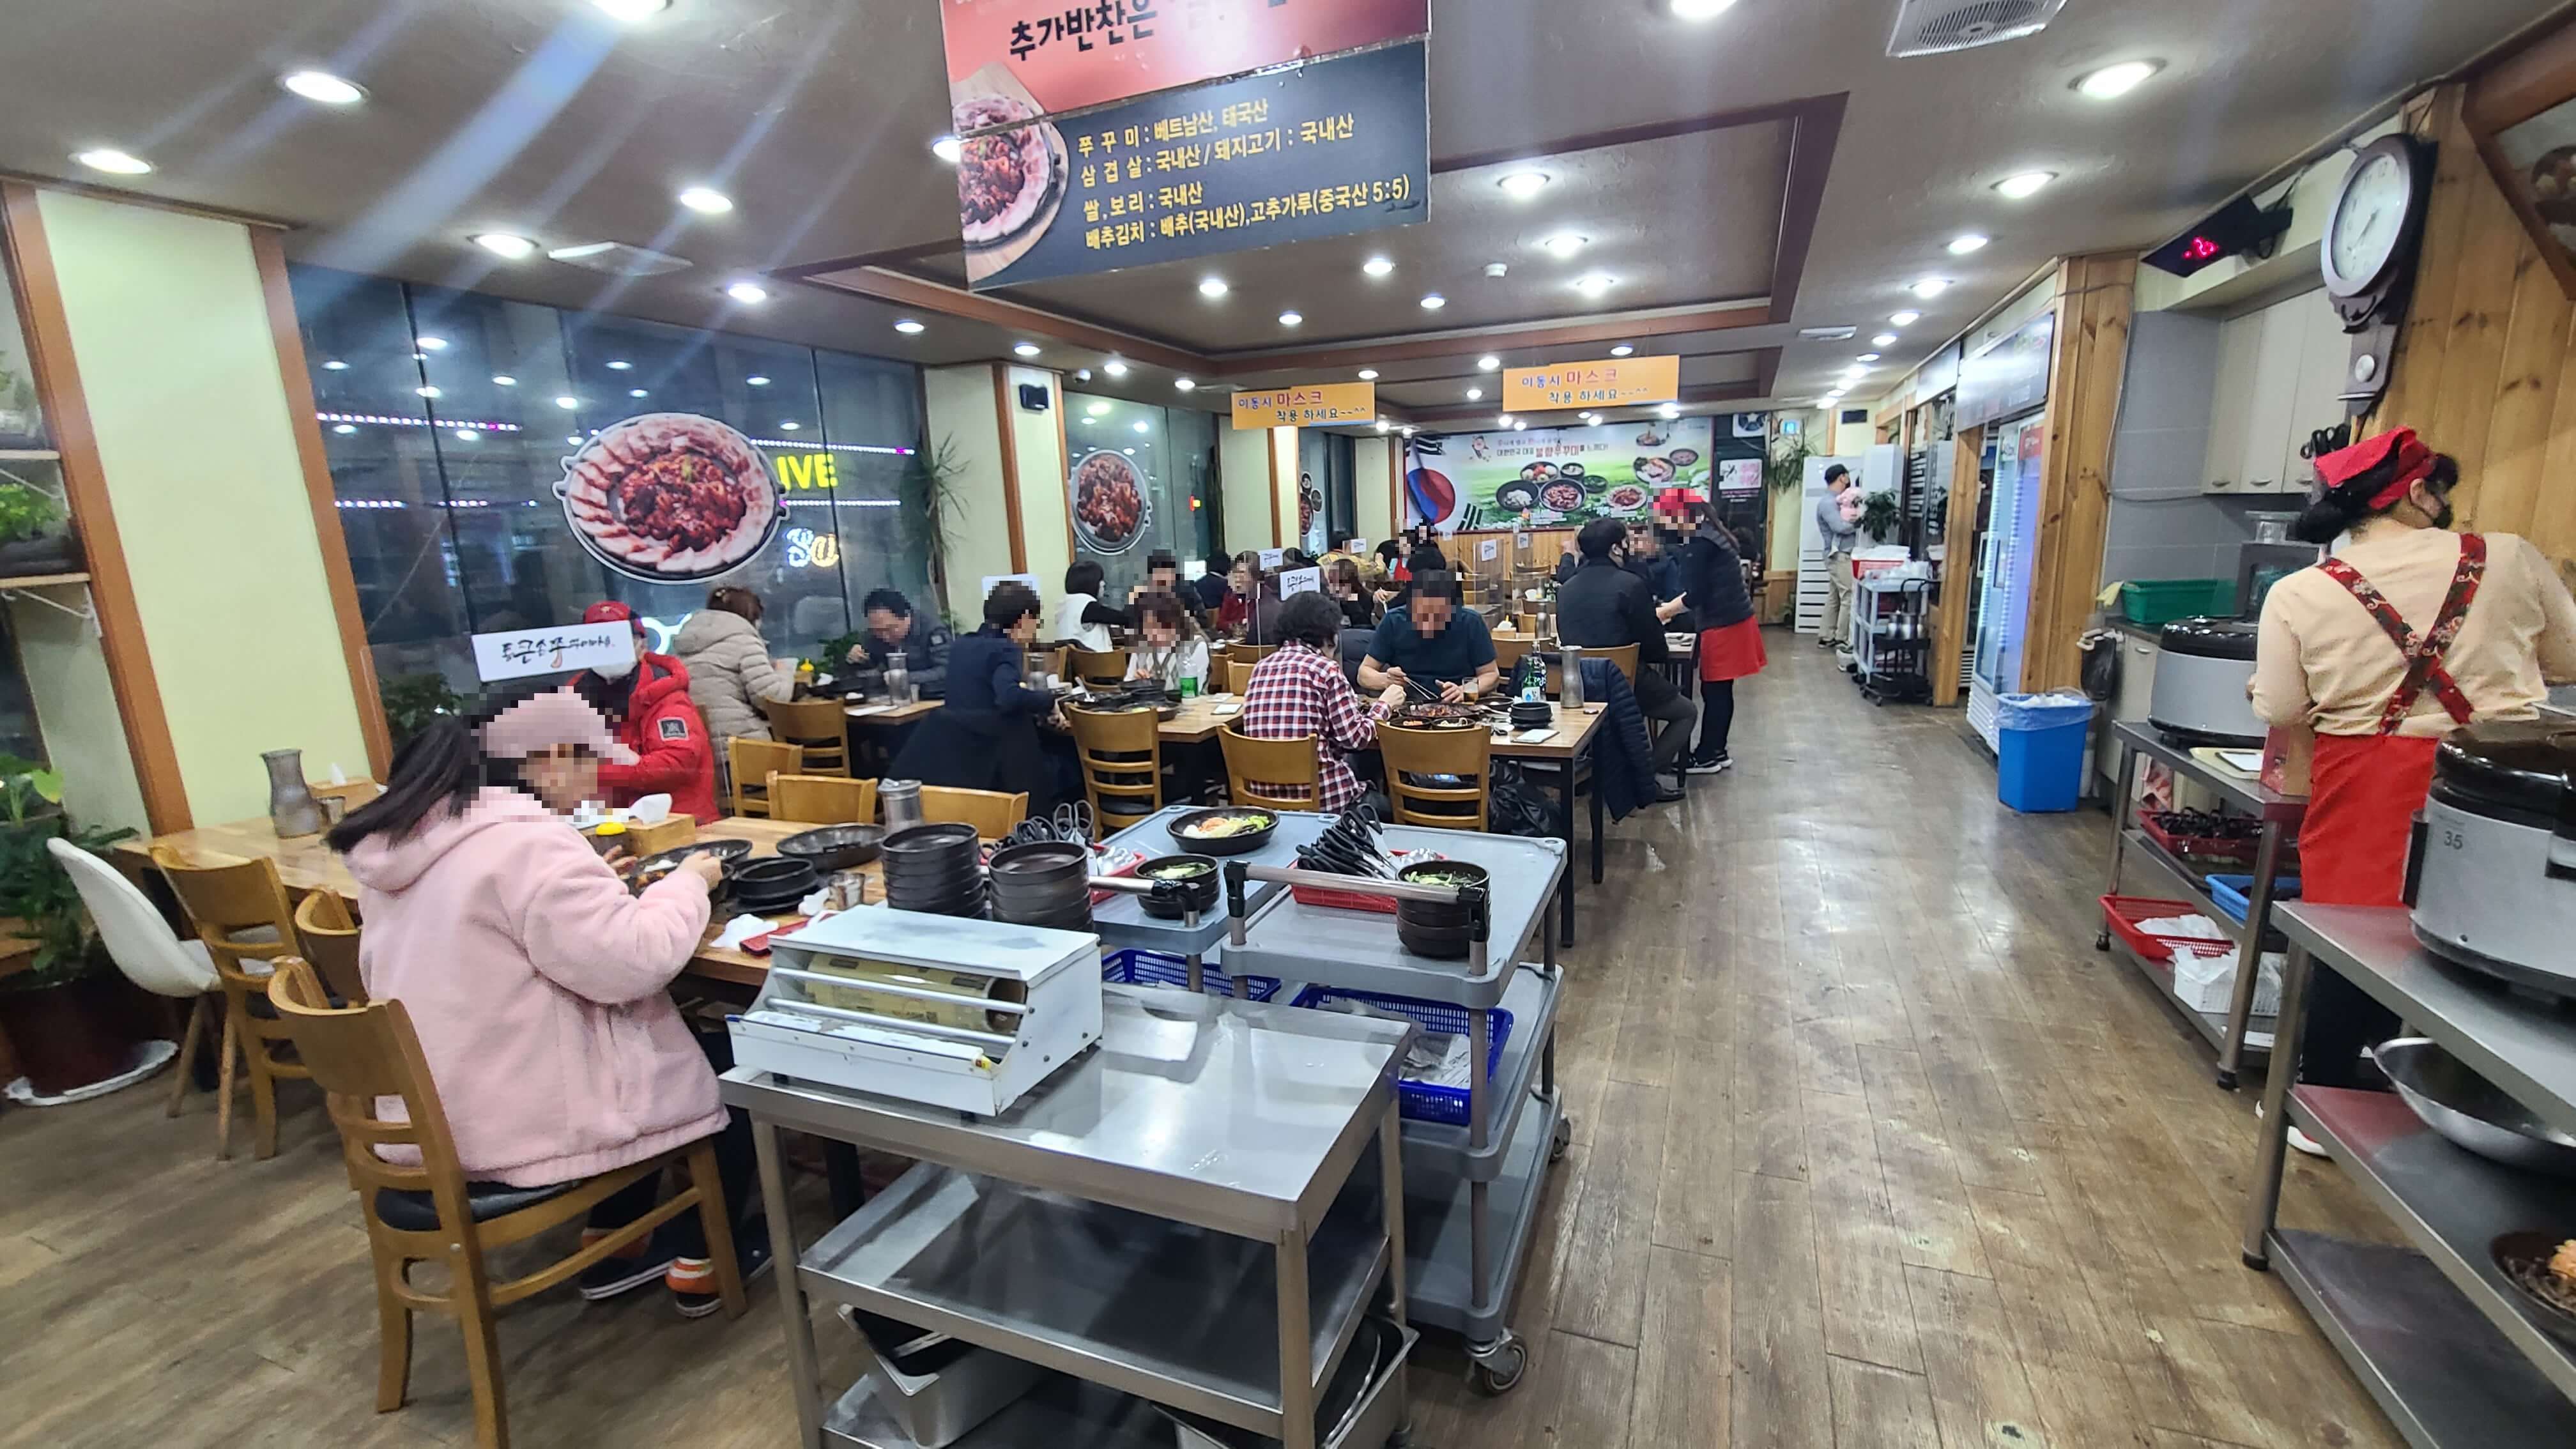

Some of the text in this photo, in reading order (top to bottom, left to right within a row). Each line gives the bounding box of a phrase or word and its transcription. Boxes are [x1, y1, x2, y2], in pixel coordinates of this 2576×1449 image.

[1009, 0, 1158, 61] 추가반찬은
[1222, 98, 1269, 127] 태국산
[1155, 142, 1201, 172] 국내산
[1214, 127, 1281, 161] 돼지고기
[1300, 112, 1355, 144] 국내산
[1158, 181, 1203, 209] 국내산
[1085, 220, 1145, 250] 배추김치
[1522, 369, 1618, 388] 이동시 마스크
[1238, 390, 1322, 410] 이동시 마스크
[1549, 391, 1572, 404] 착용
[1277, 409, 1298, 422] 착용
[2444, 831, 2463, 850] 35
